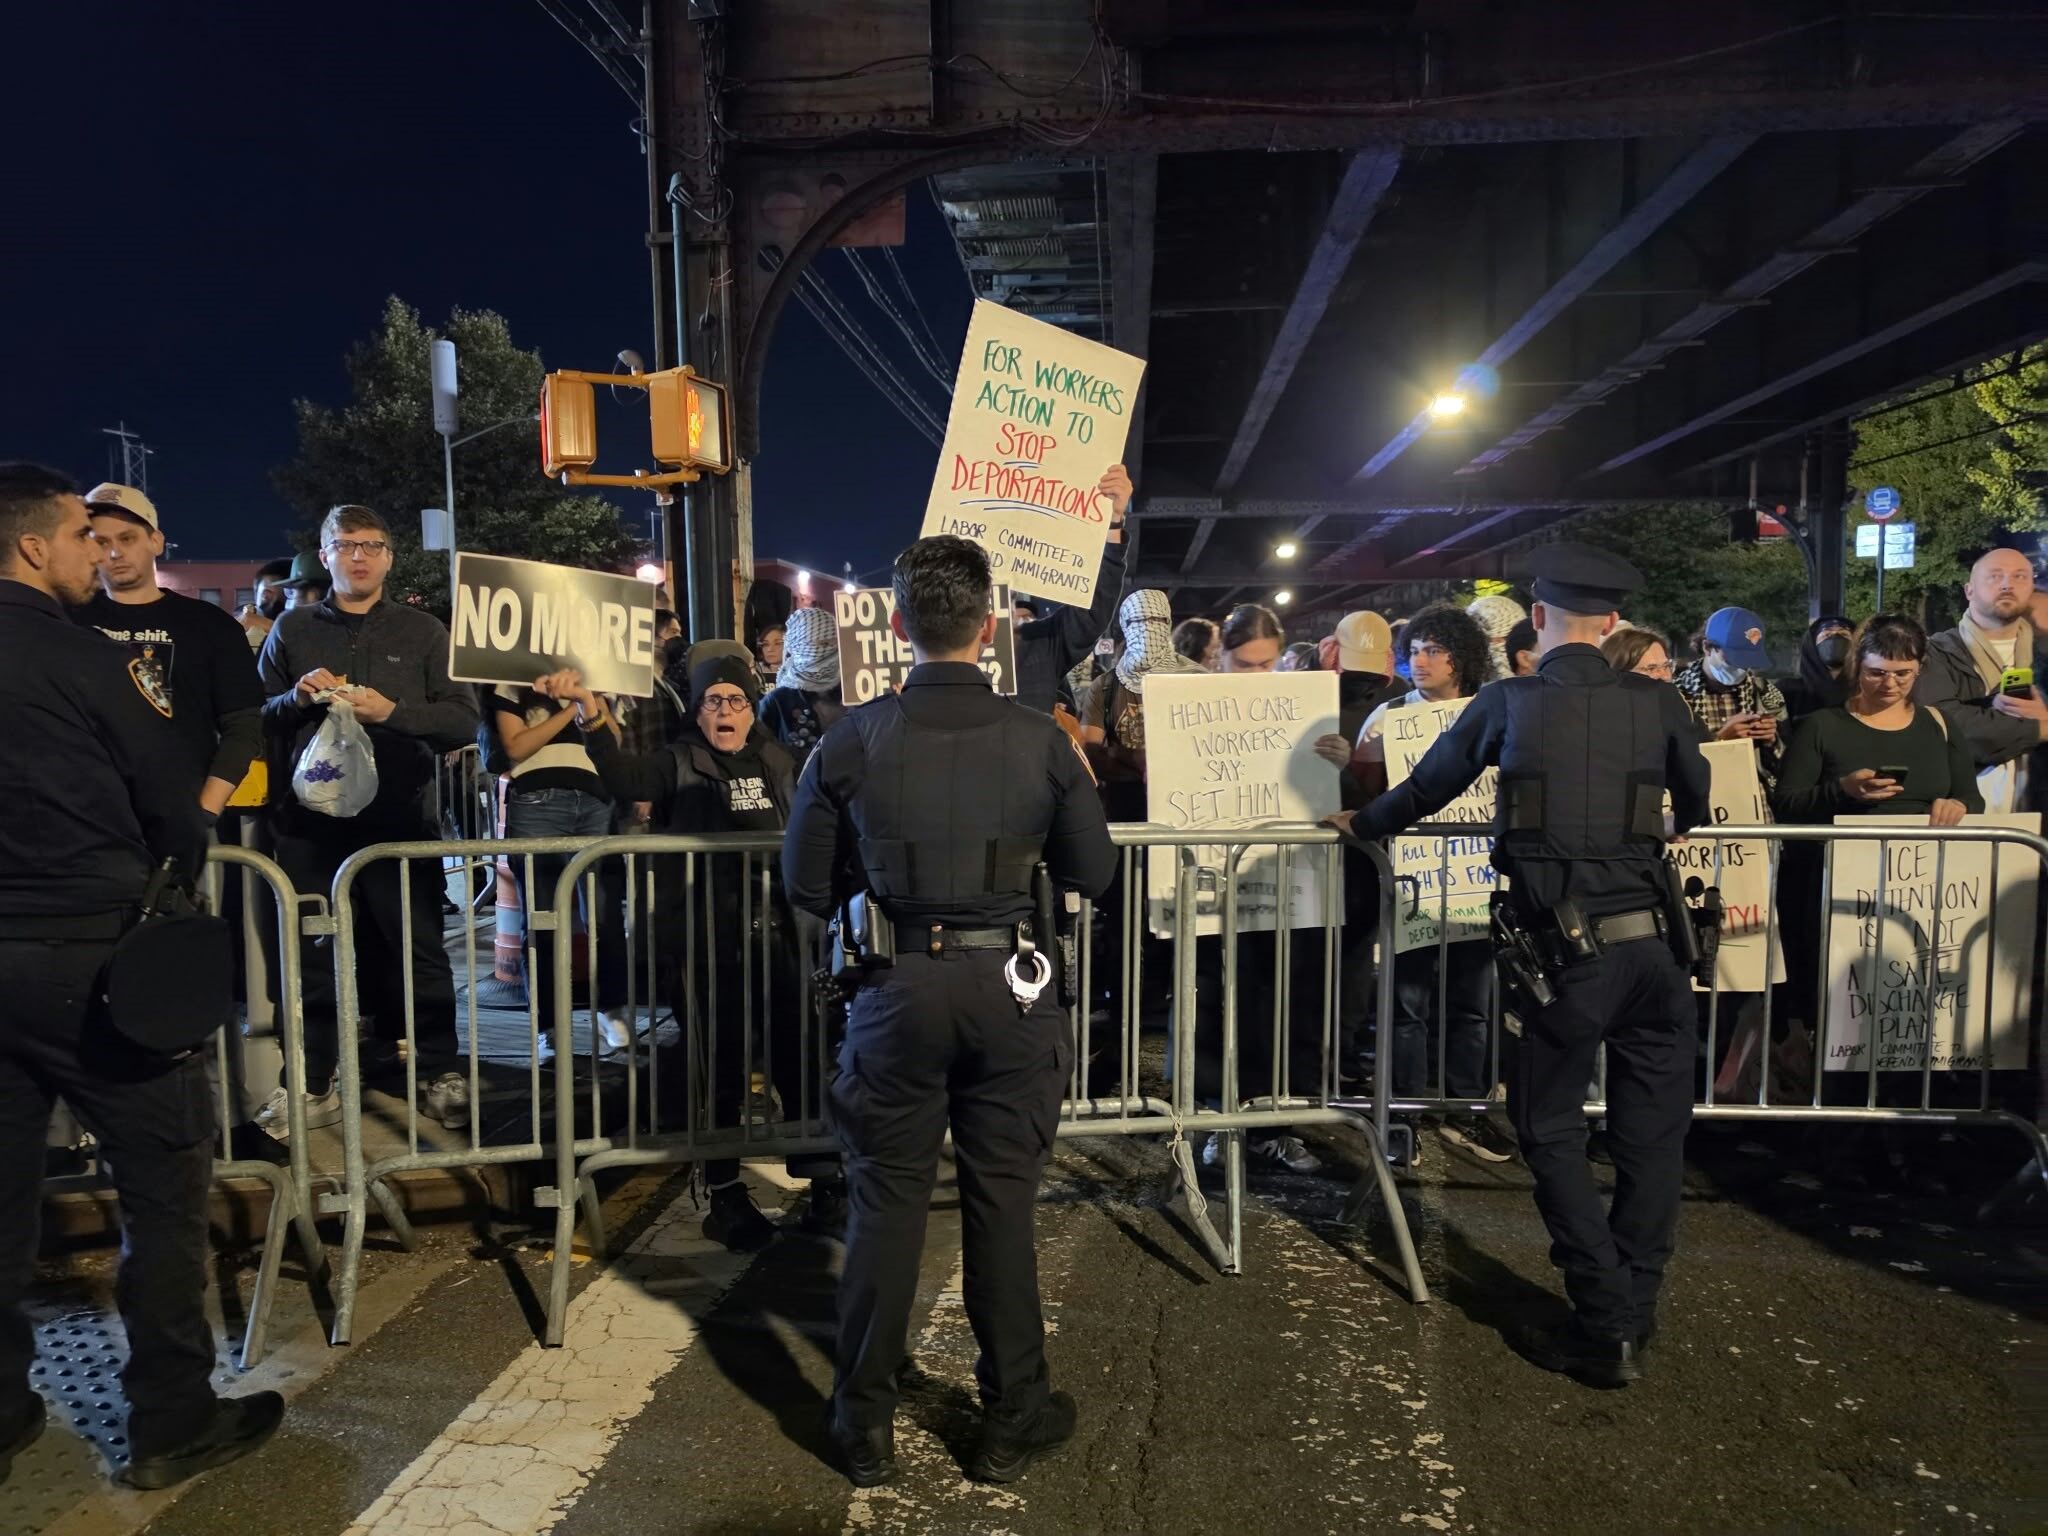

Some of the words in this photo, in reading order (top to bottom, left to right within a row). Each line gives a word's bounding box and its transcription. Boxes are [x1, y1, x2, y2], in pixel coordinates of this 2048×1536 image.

[983, 340, 1022, 380] FOR
[1035, 360, 1123, 415] WORKERS
[975, 381, 1055, 427] ACTION
[1067, 412, 1093, 444] TO
[995, 423, 1056, 463] STOP
[951, 454, 1103, 523] DEPORTATIONS
[940, 515, 987, 539] LABOR
[999, 528, 1071, 563] COMMITTEE
[1071, 554, 1084, 568] TO
[1011, 556, 1090, 593] IMMIGRANTS
[455, 584, 522, 651] NO
[530, 592, 653, 666] MORE
[837, 592, 876, 627] DO
[134, 629, 173, 643] shit.
[855, 667, 891, 702] OF
[1249, 696, 1304, 722] CARE
[1193, 728, 1292, 758] WORKERS
[1395, 715, 1423, 740] ICE
[1201, 759, 1246, 782] SAY:
[1169, 788, 1225, 827] SET
[1236, 783, 1281, 818] HIM
[1402, 843, 1427, 863] FULL
[1887, 843, 1928, 882] ICE
[1402, 865, 1456, 895] RGHTS
[1466, 864, 1496, 885] FOR
[1859, 924, 1877, 947] IS
[1848, 963, 1860, 990] A
[1830, 1042, 1866, 1058] LABOR
